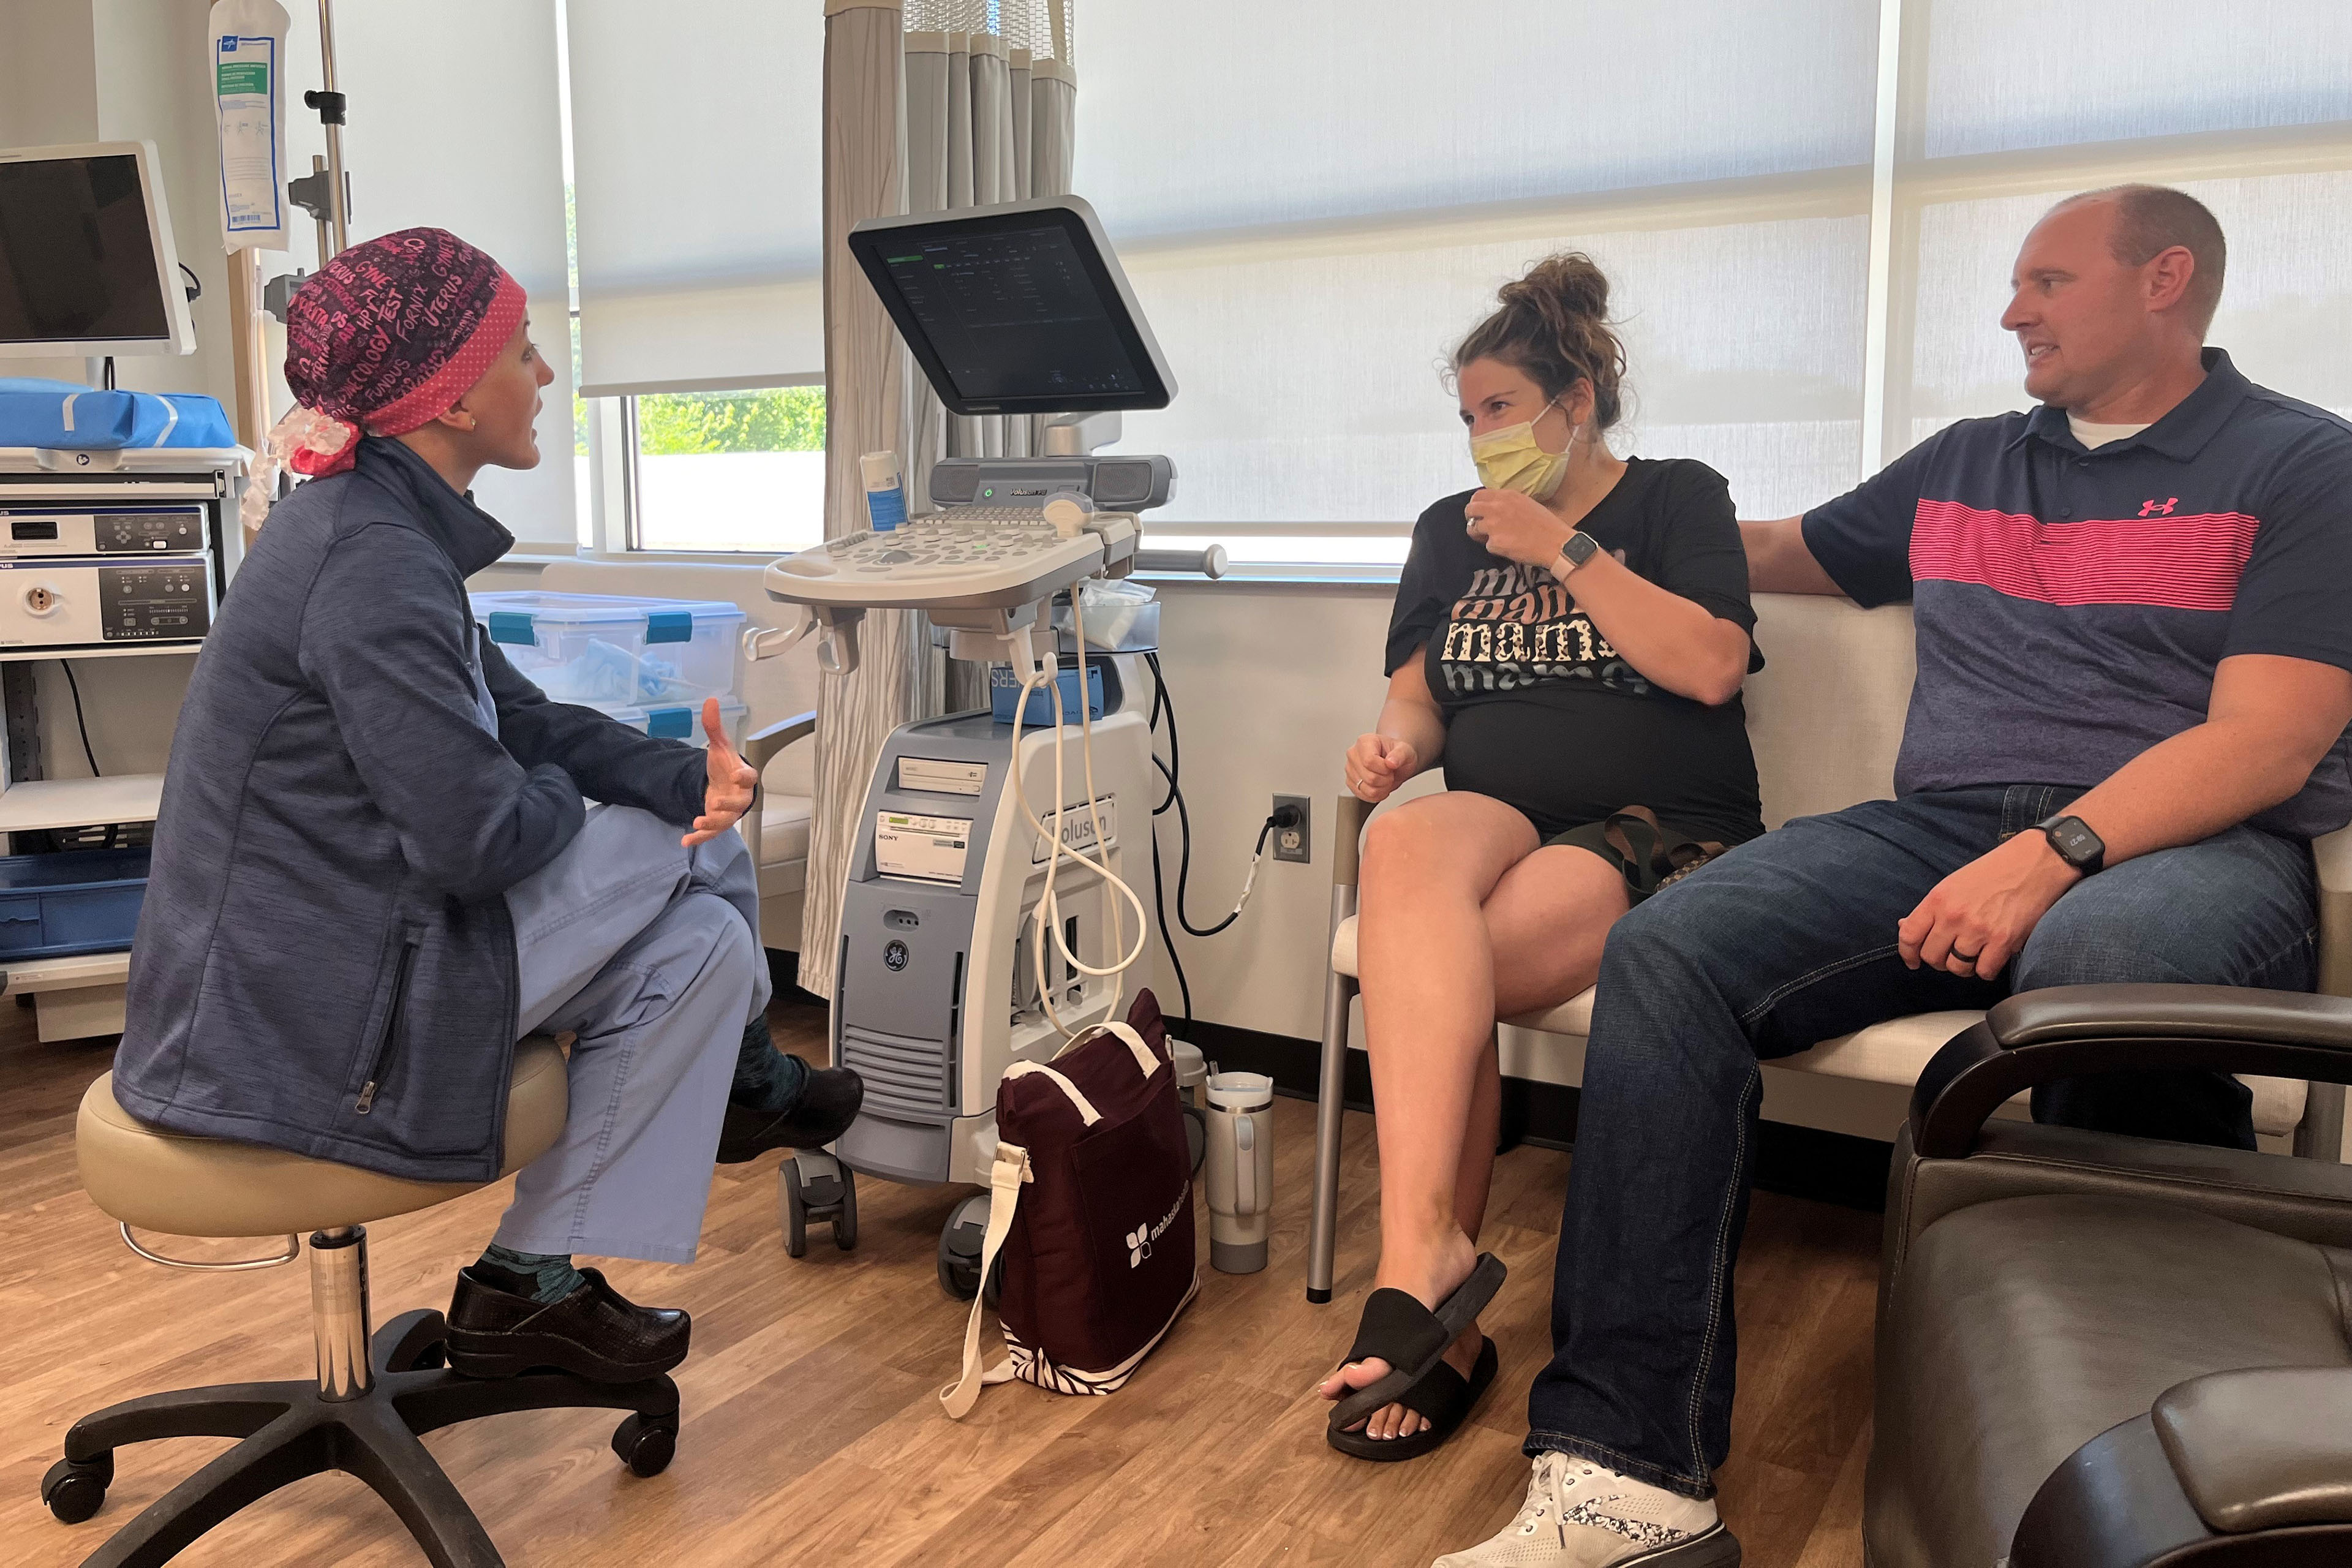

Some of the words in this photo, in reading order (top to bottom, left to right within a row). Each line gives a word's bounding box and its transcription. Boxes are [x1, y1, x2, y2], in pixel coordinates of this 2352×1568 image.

[378, 287, 404, 323] TEST
[396, 282, 428, 343] FORNIX
[422, 274, 463, 327] UTERUS
[365, 358, 411, 402] FUNDUS
[1450, 584, 1587, 625] mam
[1440, 619, 1619, 663] mam
